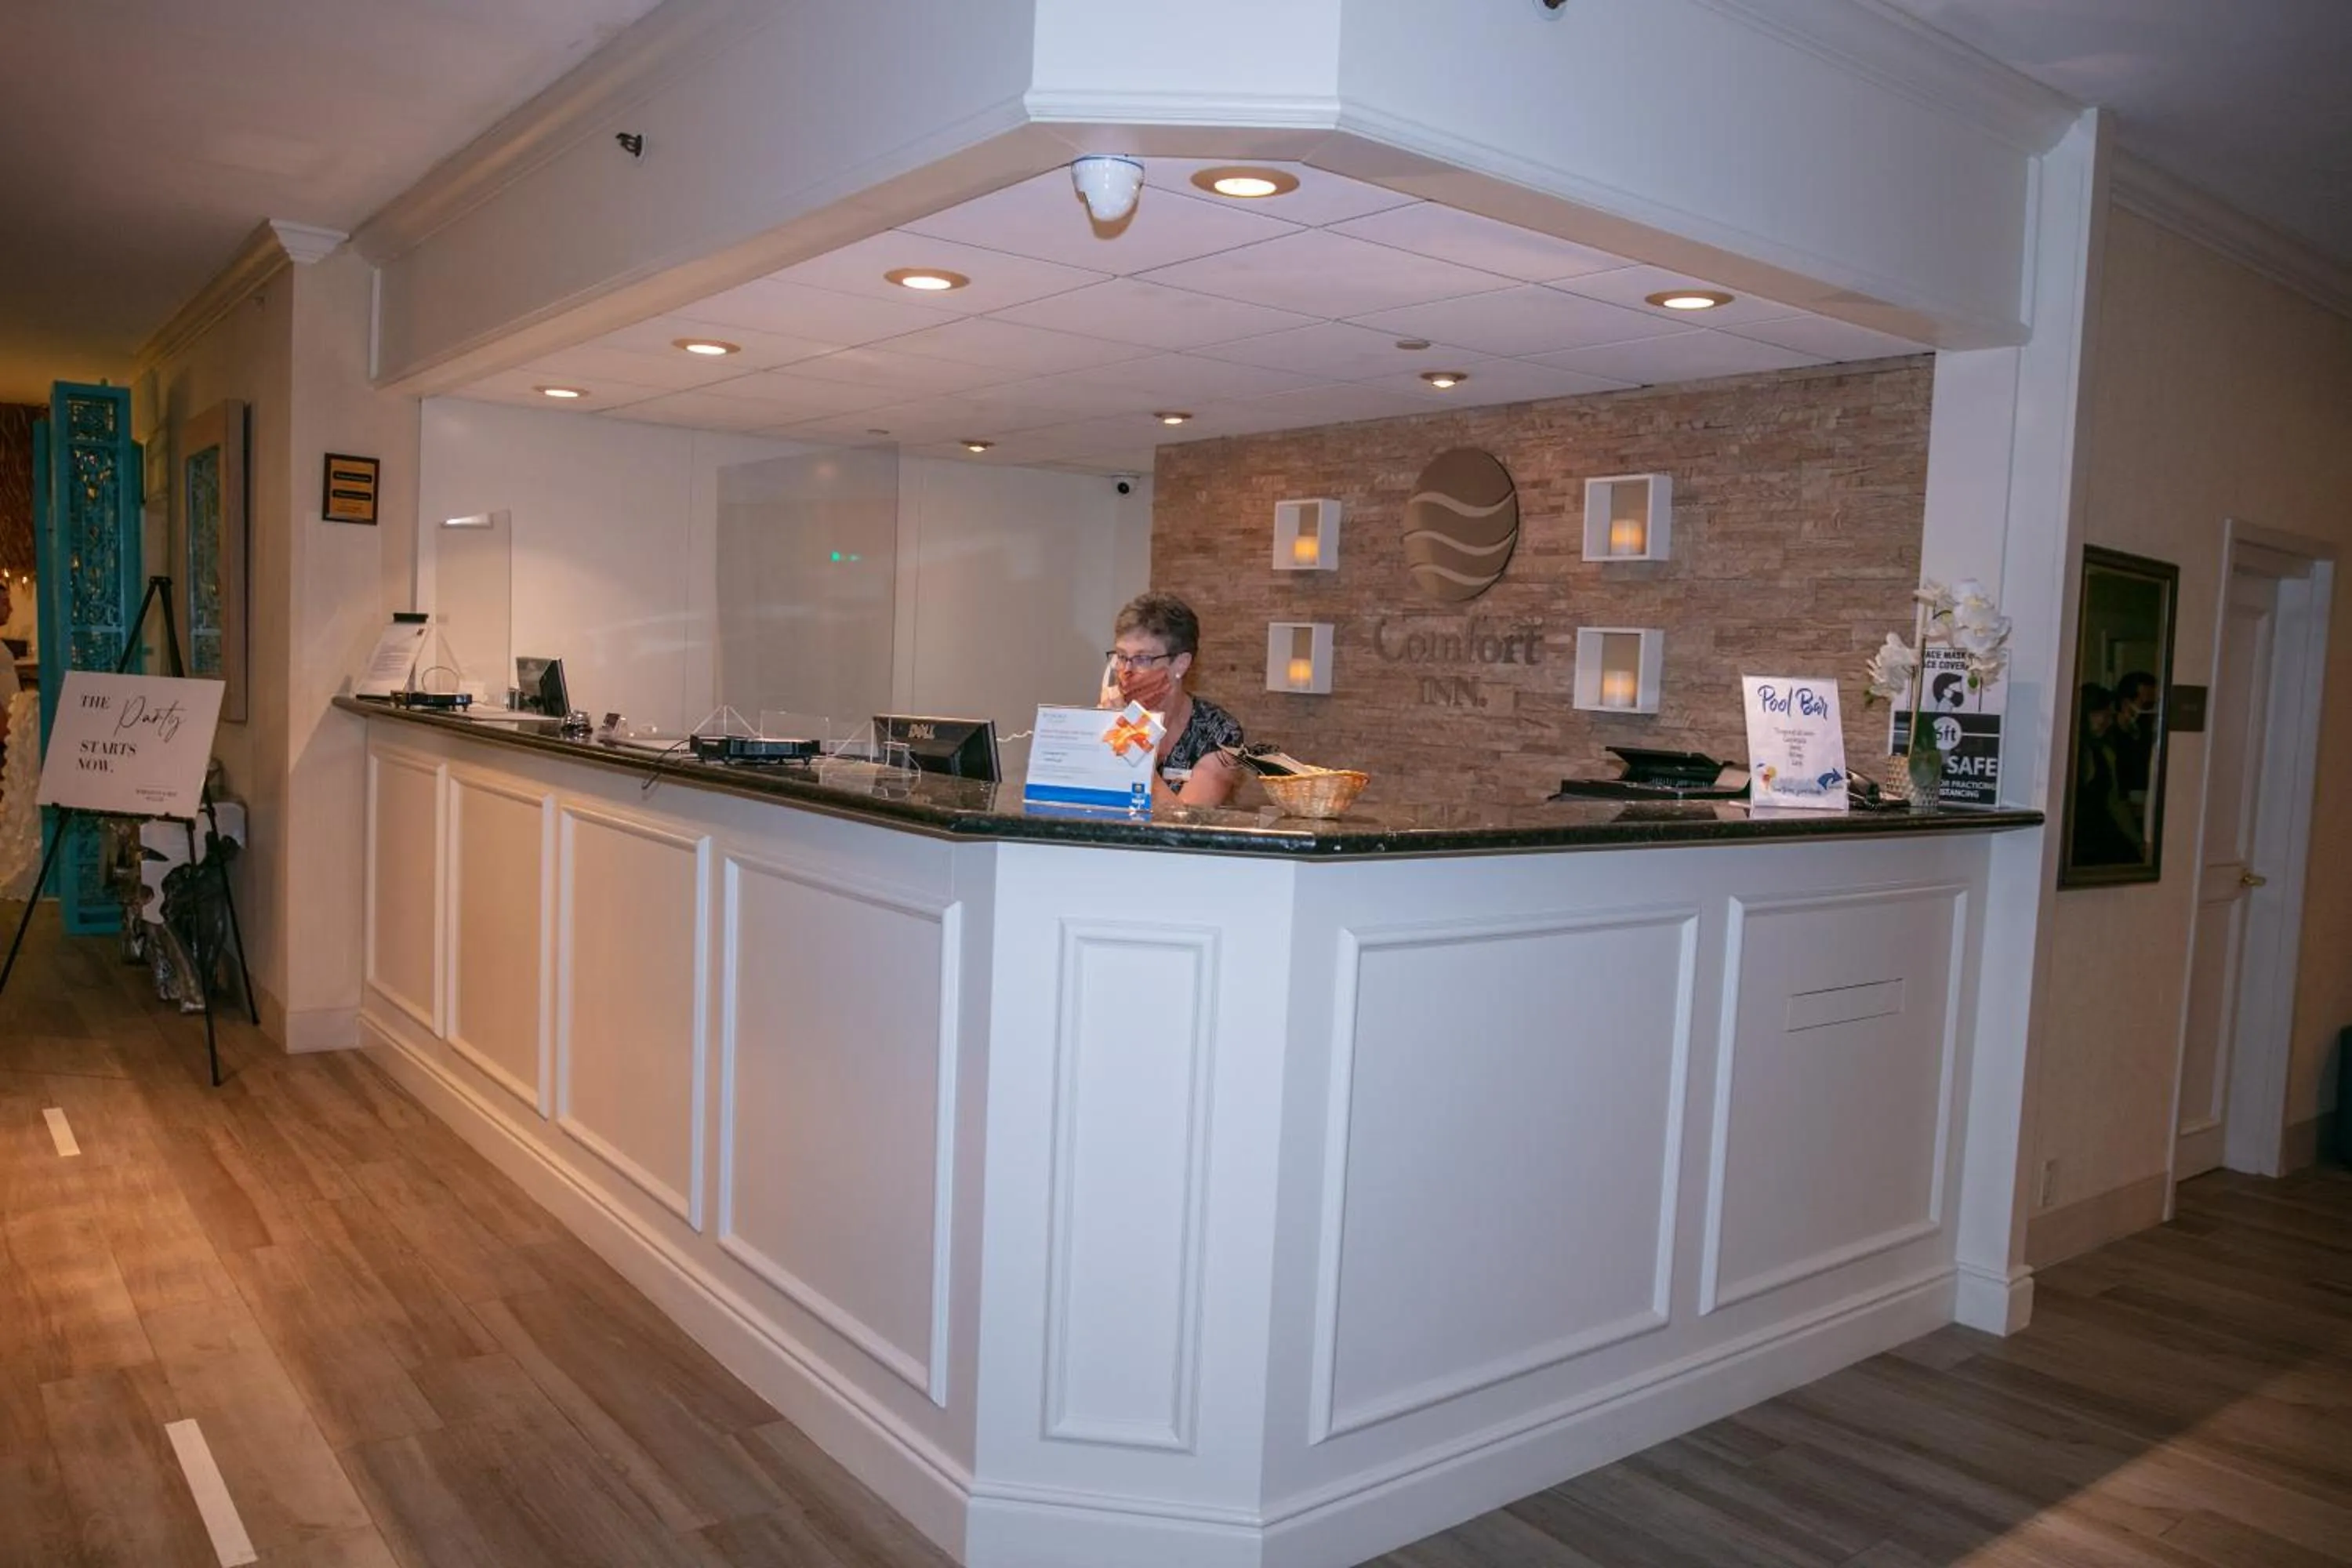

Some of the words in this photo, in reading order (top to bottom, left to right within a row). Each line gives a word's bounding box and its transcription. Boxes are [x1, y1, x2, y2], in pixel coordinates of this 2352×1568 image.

[1374, 614, 1544, 665] Comfort
[1925, 650, 1943, 659] ACE
[1944, 652, 1966, 660] MASK
[1757, 684, 1793, 718] Pool
[1795, 688, 1828, 720] Bar
[81, 695, 112, 710] THE
[114, 695, 187, 743] Party
[79, 739, 137, 757] STARTS
[76, 757, 114, 773] NOW.
[1947, 755, 1998, 777] SAFE
